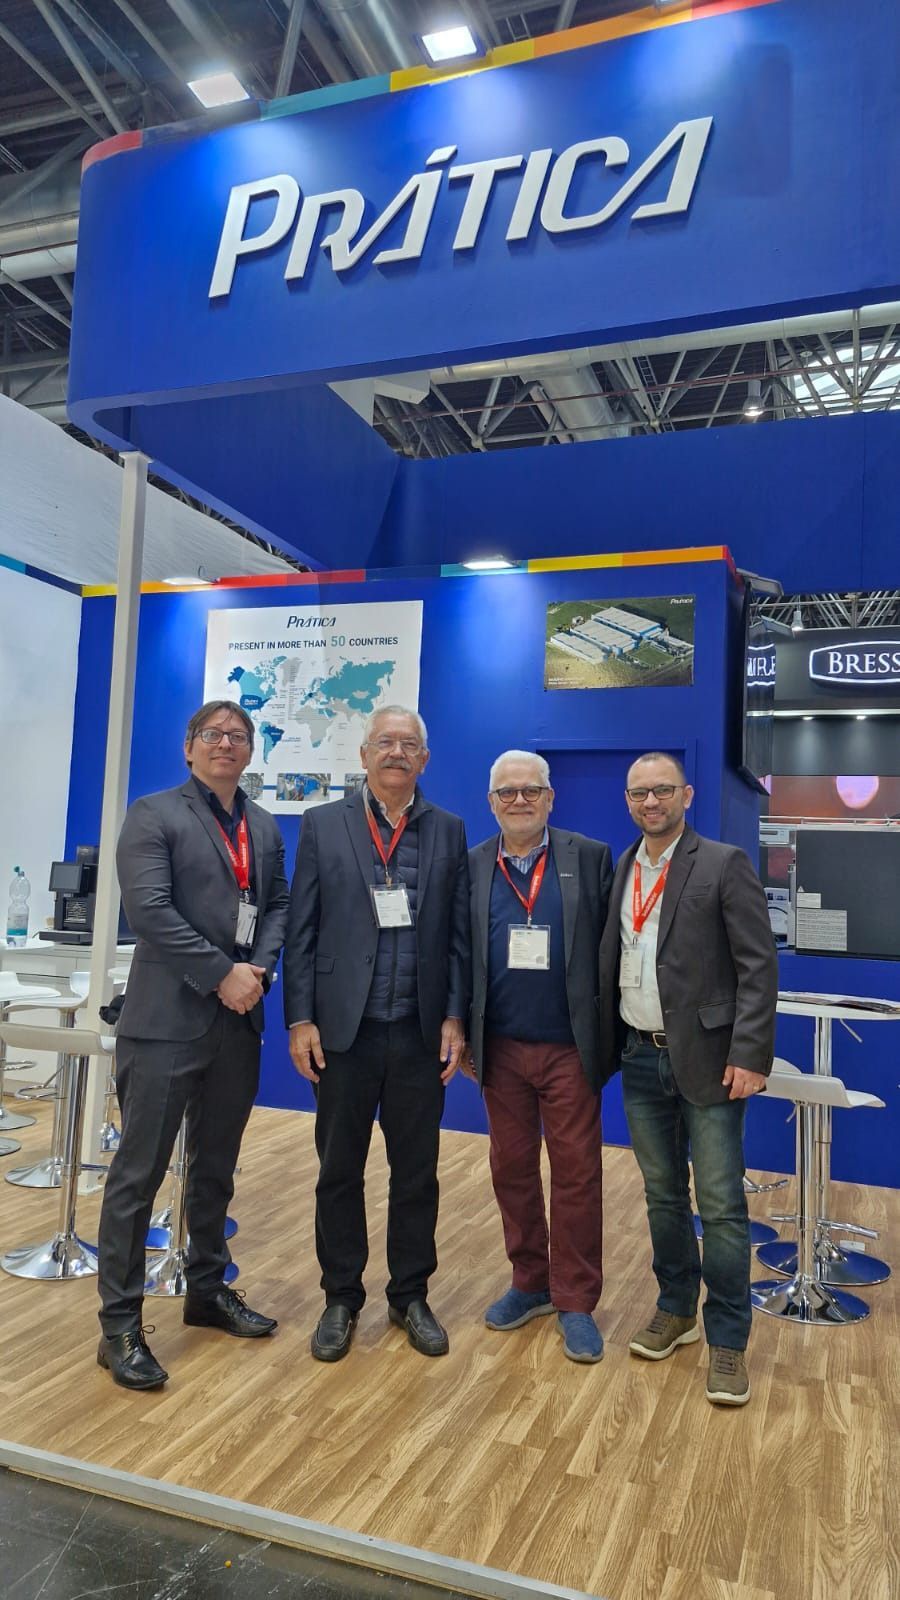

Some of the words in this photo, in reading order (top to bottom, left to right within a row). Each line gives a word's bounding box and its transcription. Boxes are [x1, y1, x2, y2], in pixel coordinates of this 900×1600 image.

[208, 116, 713, 298] PRÁTICA
[228, 641, 265, 651] PRESENT
[267, 640, 276, 650] IN
[277, 640, 301, 649] MORE
[303, 639, 327, 648] THAN
[331, 635, 346, 648] 50
[349, 636, 399, 647] COUNTRIES
